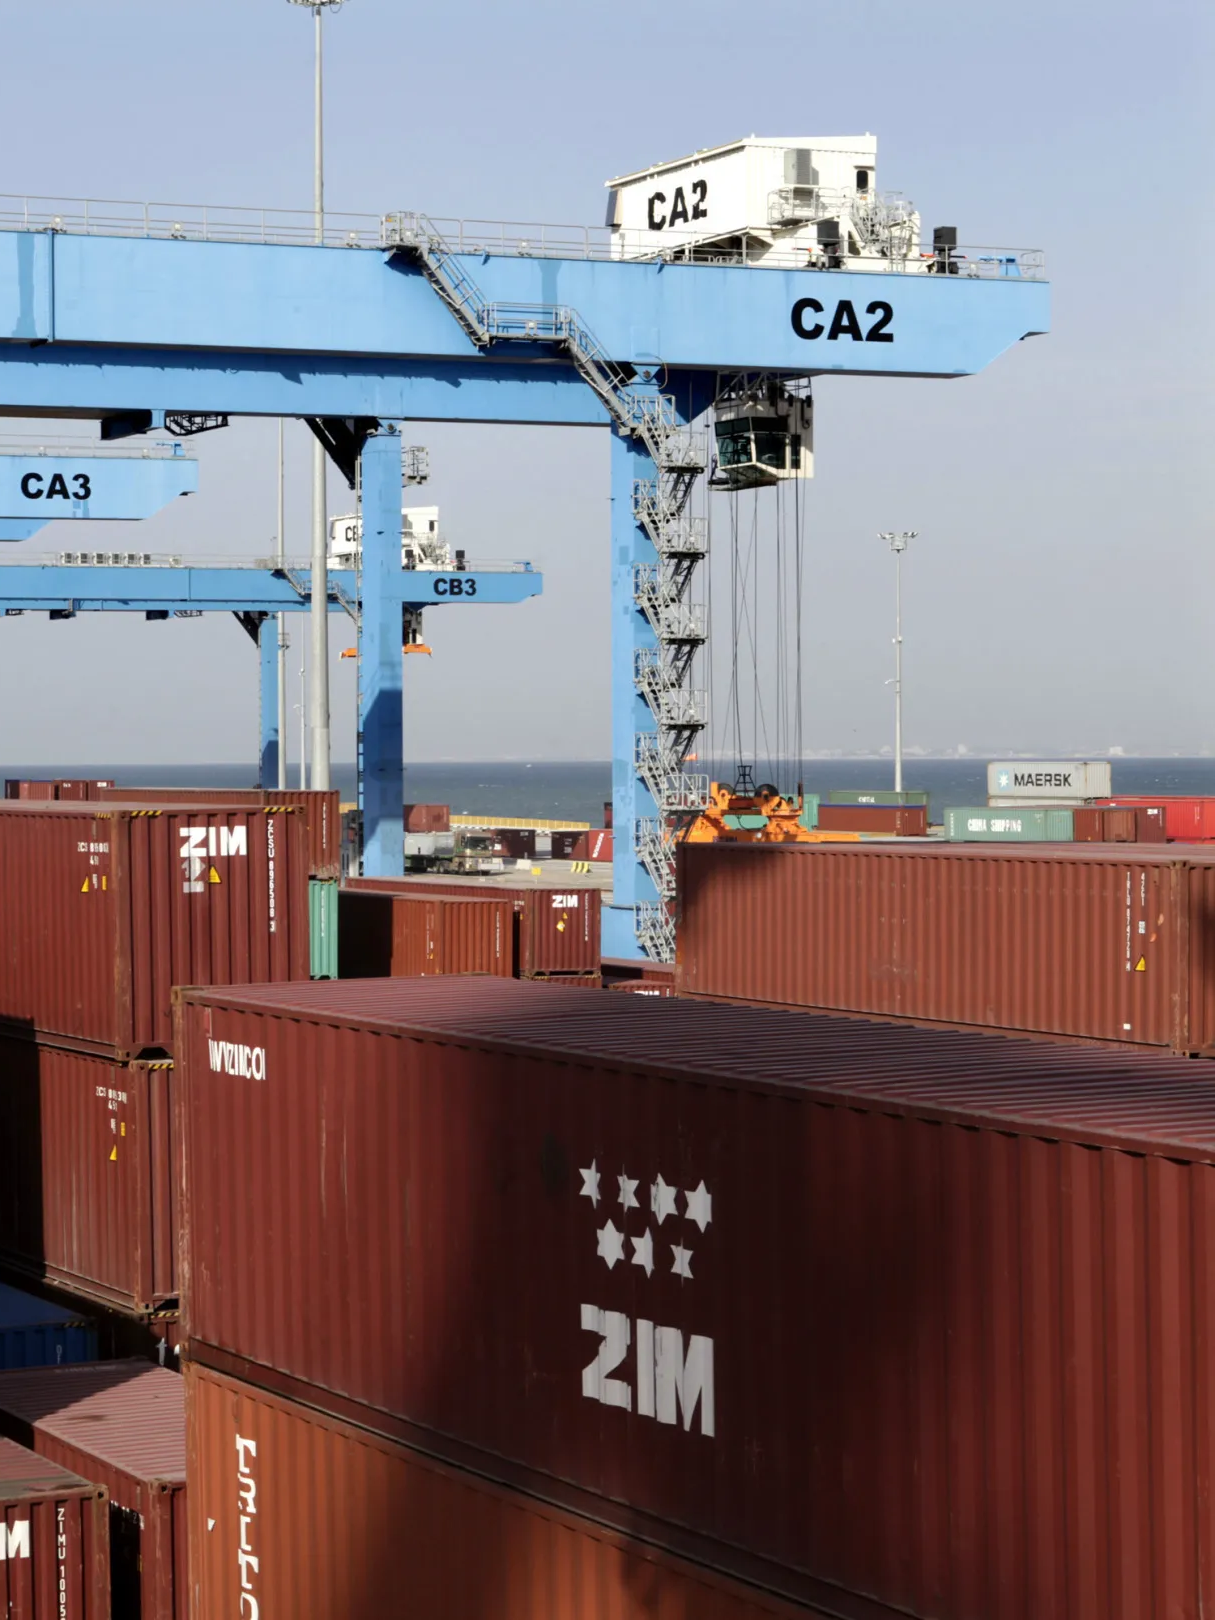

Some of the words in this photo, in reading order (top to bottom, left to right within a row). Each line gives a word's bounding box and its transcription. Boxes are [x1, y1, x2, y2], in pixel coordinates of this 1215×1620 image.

[647, 179, 708, 231] CA2
[790, 297, 894, 343] CA2
[20, 472, 92, 500] CA3
[345, 525, 361, 542] CB
[433, 578, 477, 596] CB3
[1013, 773, 1072, 788] MAERSK
[179, 825, 248, 858] ZIM
[267, 819, 275, 858] ZCSU
[967, 818, 987, 832] CHINA
[990, 818, 1022, 833] SHIPPING
[551, 894, 579, 908] ZIM
[580, 1303, 715, 1438] ZIM
[57, 1507, 67, 1560] ZIMU
[59, 1565, 67, 1620] 1005
